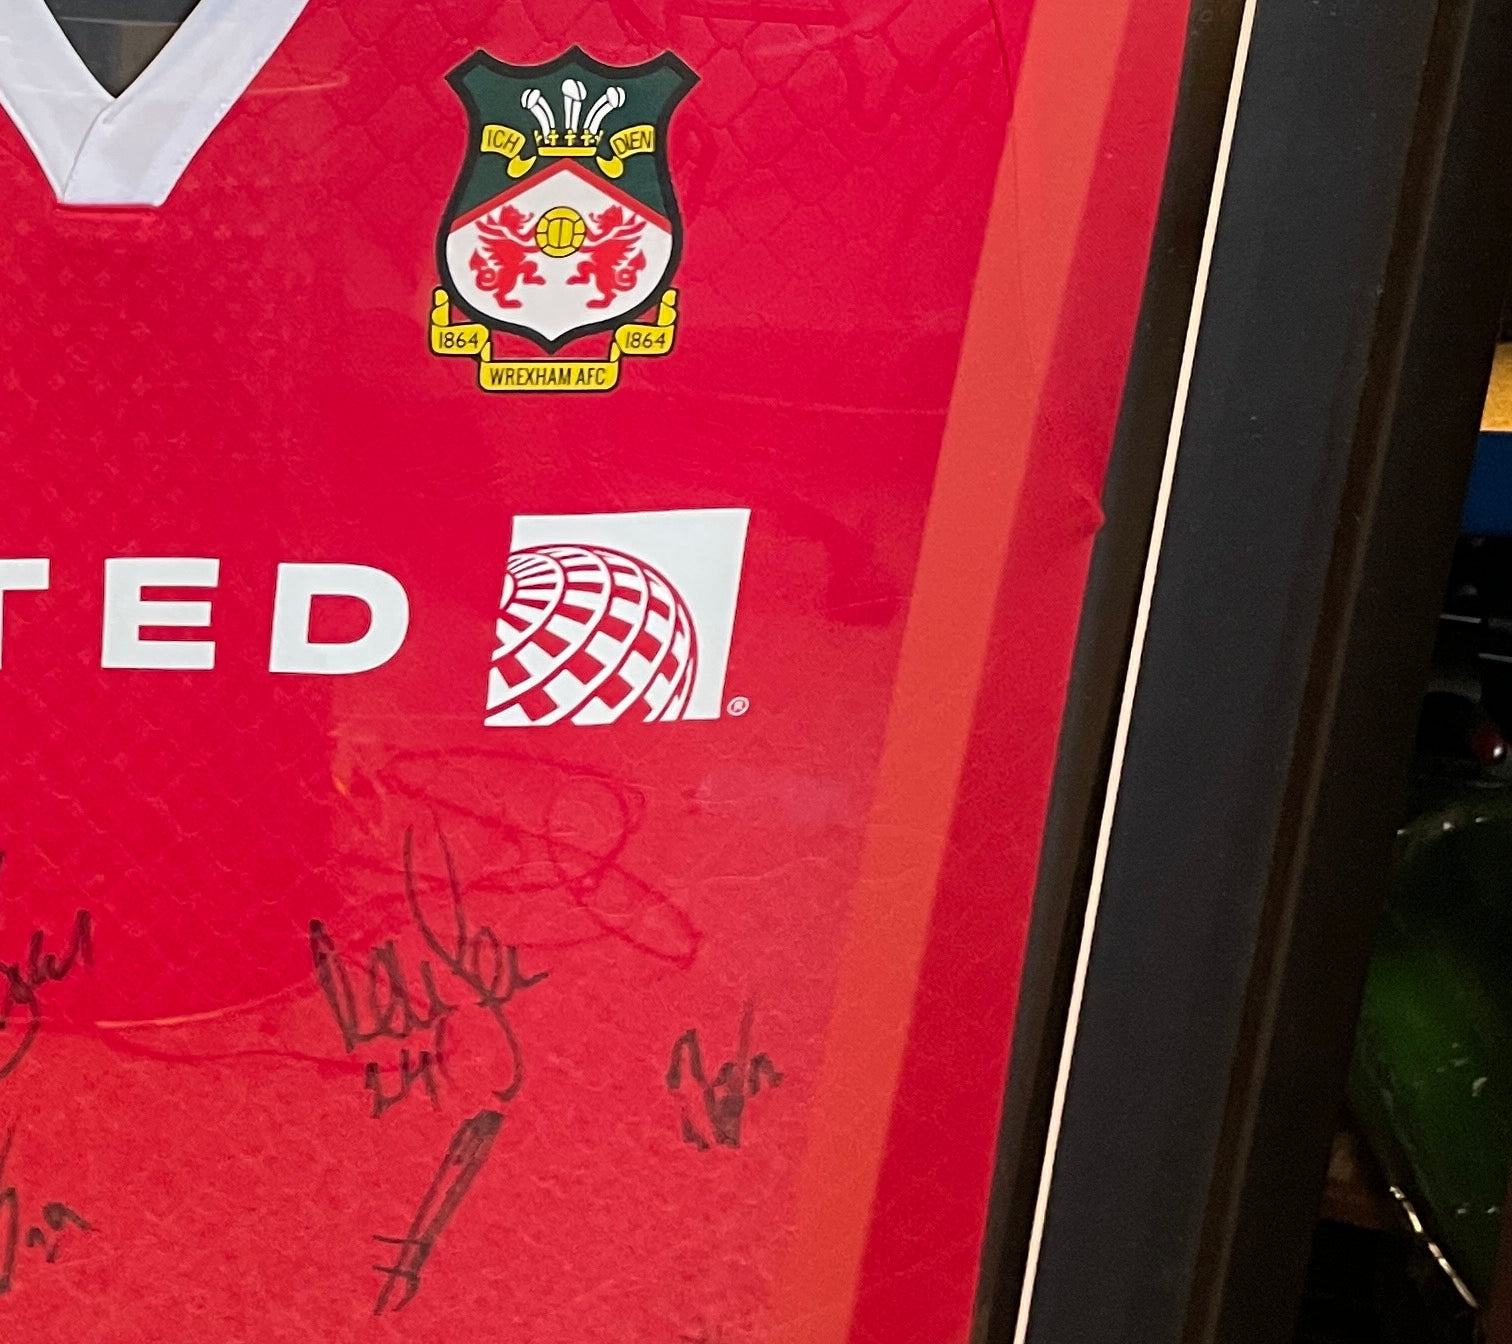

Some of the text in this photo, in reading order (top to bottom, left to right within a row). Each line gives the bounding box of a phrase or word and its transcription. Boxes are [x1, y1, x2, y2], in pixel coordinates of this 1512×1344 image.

[486, 129, 653, 155] ICH DIEN
[438, 329, 479, 349] 1864
[625, 329, 666, 348] 1864
[489, 367, 607, 387] WREXHAM AFC
